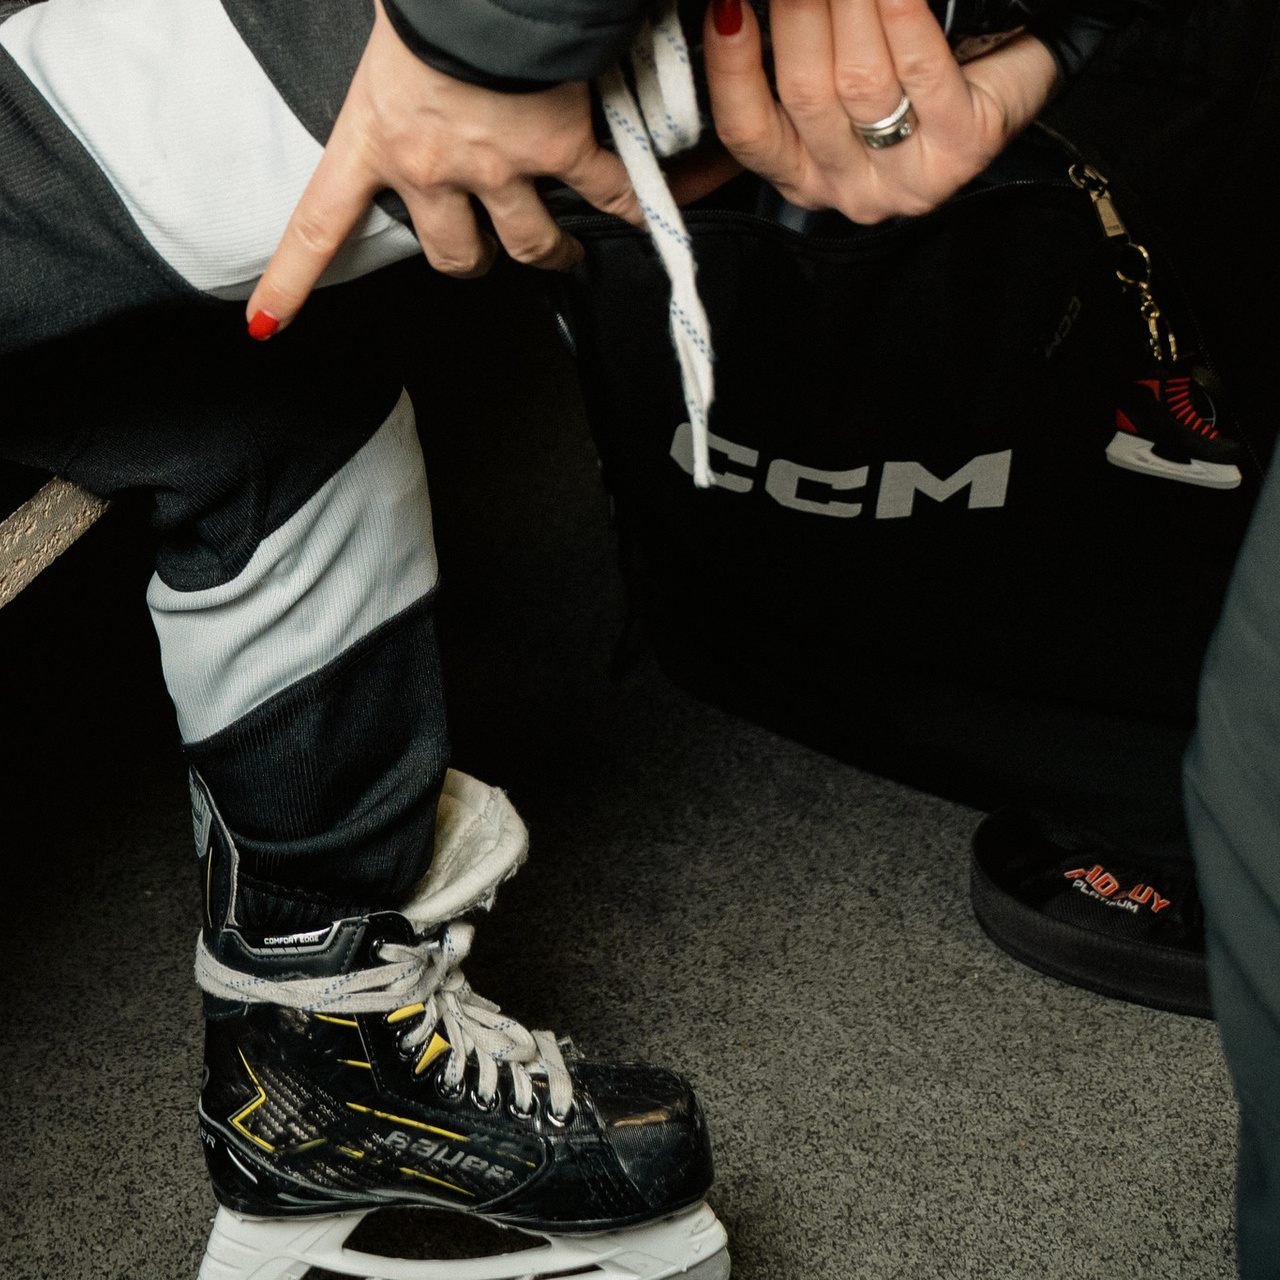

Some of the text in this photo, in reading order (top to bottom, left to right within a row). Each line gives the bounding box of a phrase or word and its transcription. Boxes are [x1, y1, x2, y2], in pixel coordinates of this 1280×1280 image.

[669, 422, 1012, 519] CCM
[263, 935, 298, 945] COMFORT
[384, 1129, 514, 1182] BAUER
